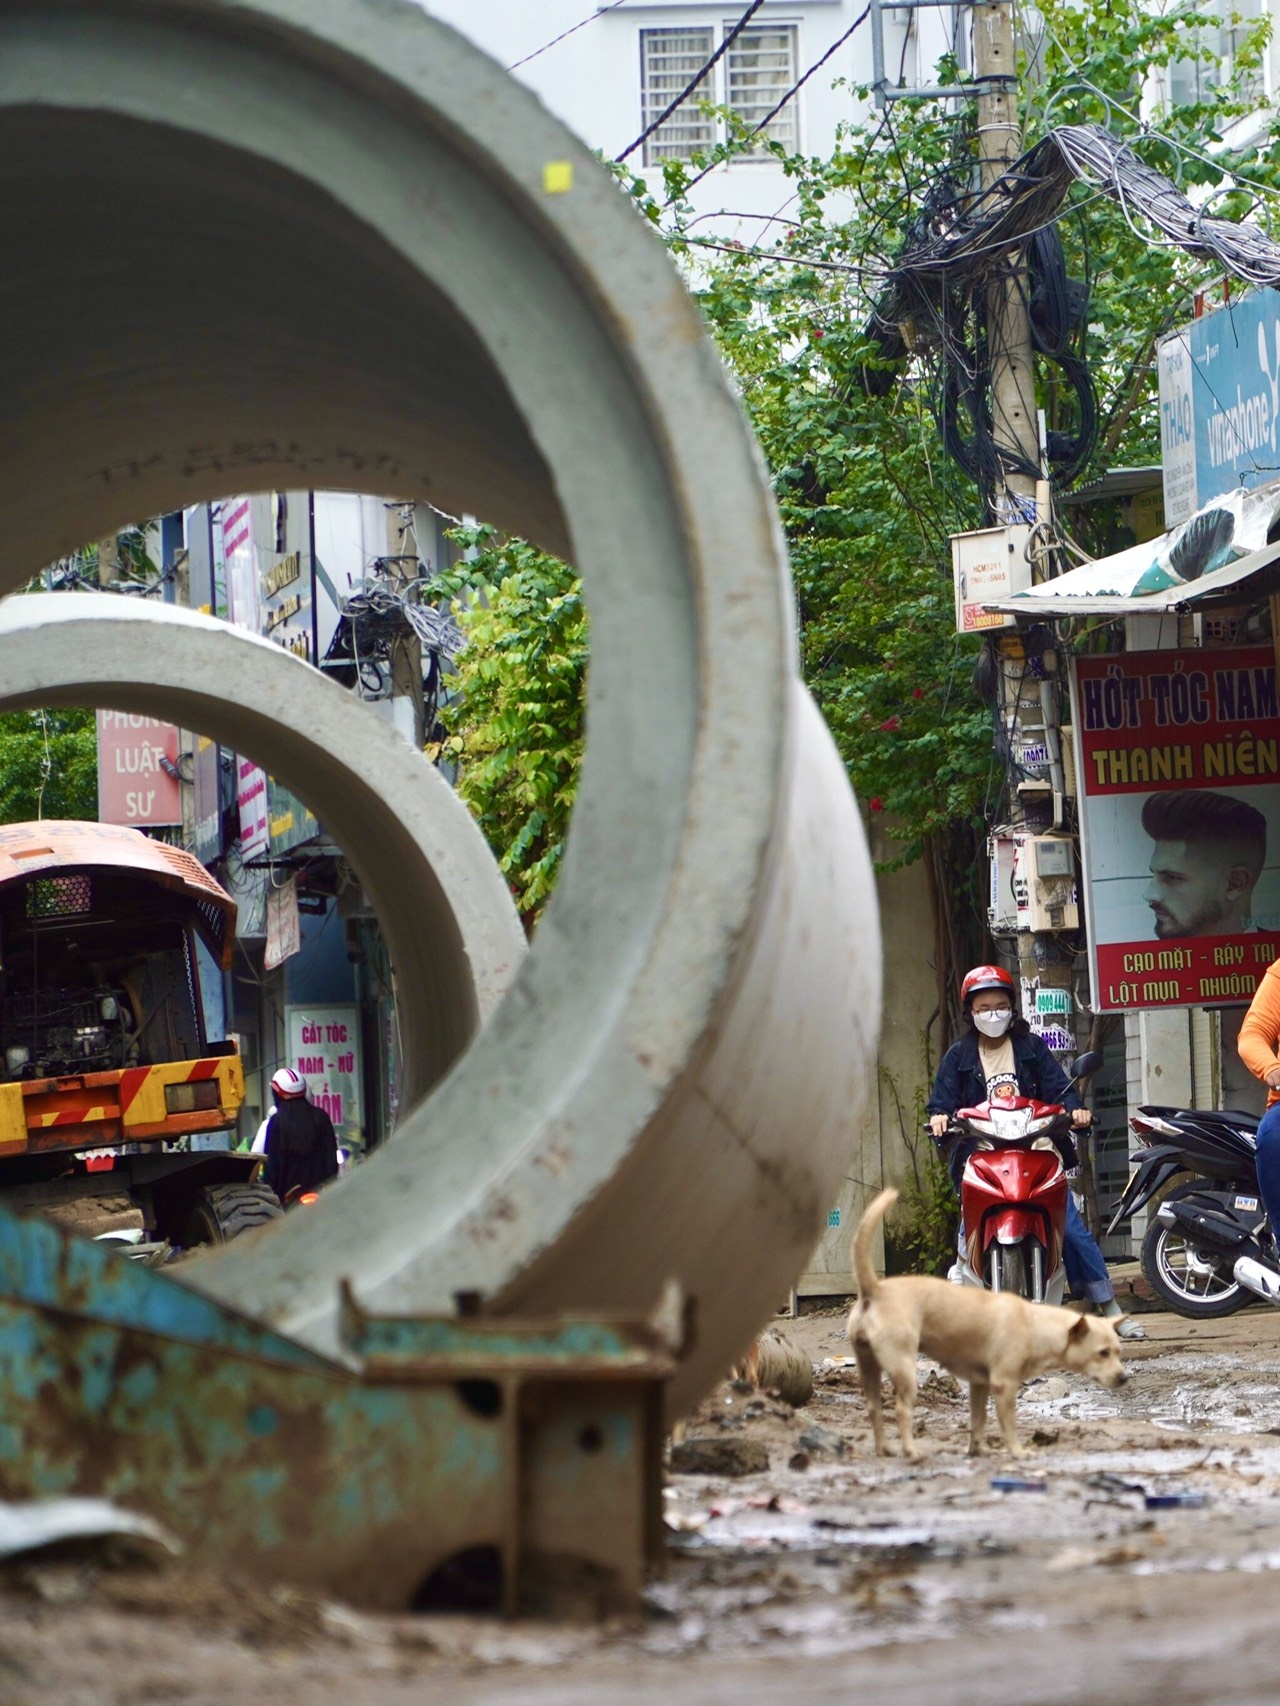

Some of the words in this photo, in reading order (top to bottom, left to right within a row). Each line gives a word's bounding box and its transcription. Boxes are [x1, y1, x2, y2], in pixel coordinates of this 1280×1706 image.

[1163, 388, 1192, 449] THẢO
[1207, 384, 1269, 470] vinaphone
[1148, 660, 1210, 727] TÓC
[1214, 667, 1280, 723] NAM
[116, 740, 166, 778] LUẬT
[1092, 744, 1194, 785] THANH
[1203, 730, 1279, 778] NIÊN
[126, 790, 155, 818] SƯ
[1123, 953, 1155, 975] CẠO
[1158, 946, 1193, 972] MẶT
[1213, 942, 1244, 966] RÁY
[1252, 942, 1276, 963] TAI
[1109, 980, 1138, 1006] LỘT
[1143, 980, 1180, 1002] MỤN
[1199, 974, 1256, 997] NHUỘM
[326, 1020, 348, 1044] TÓC
